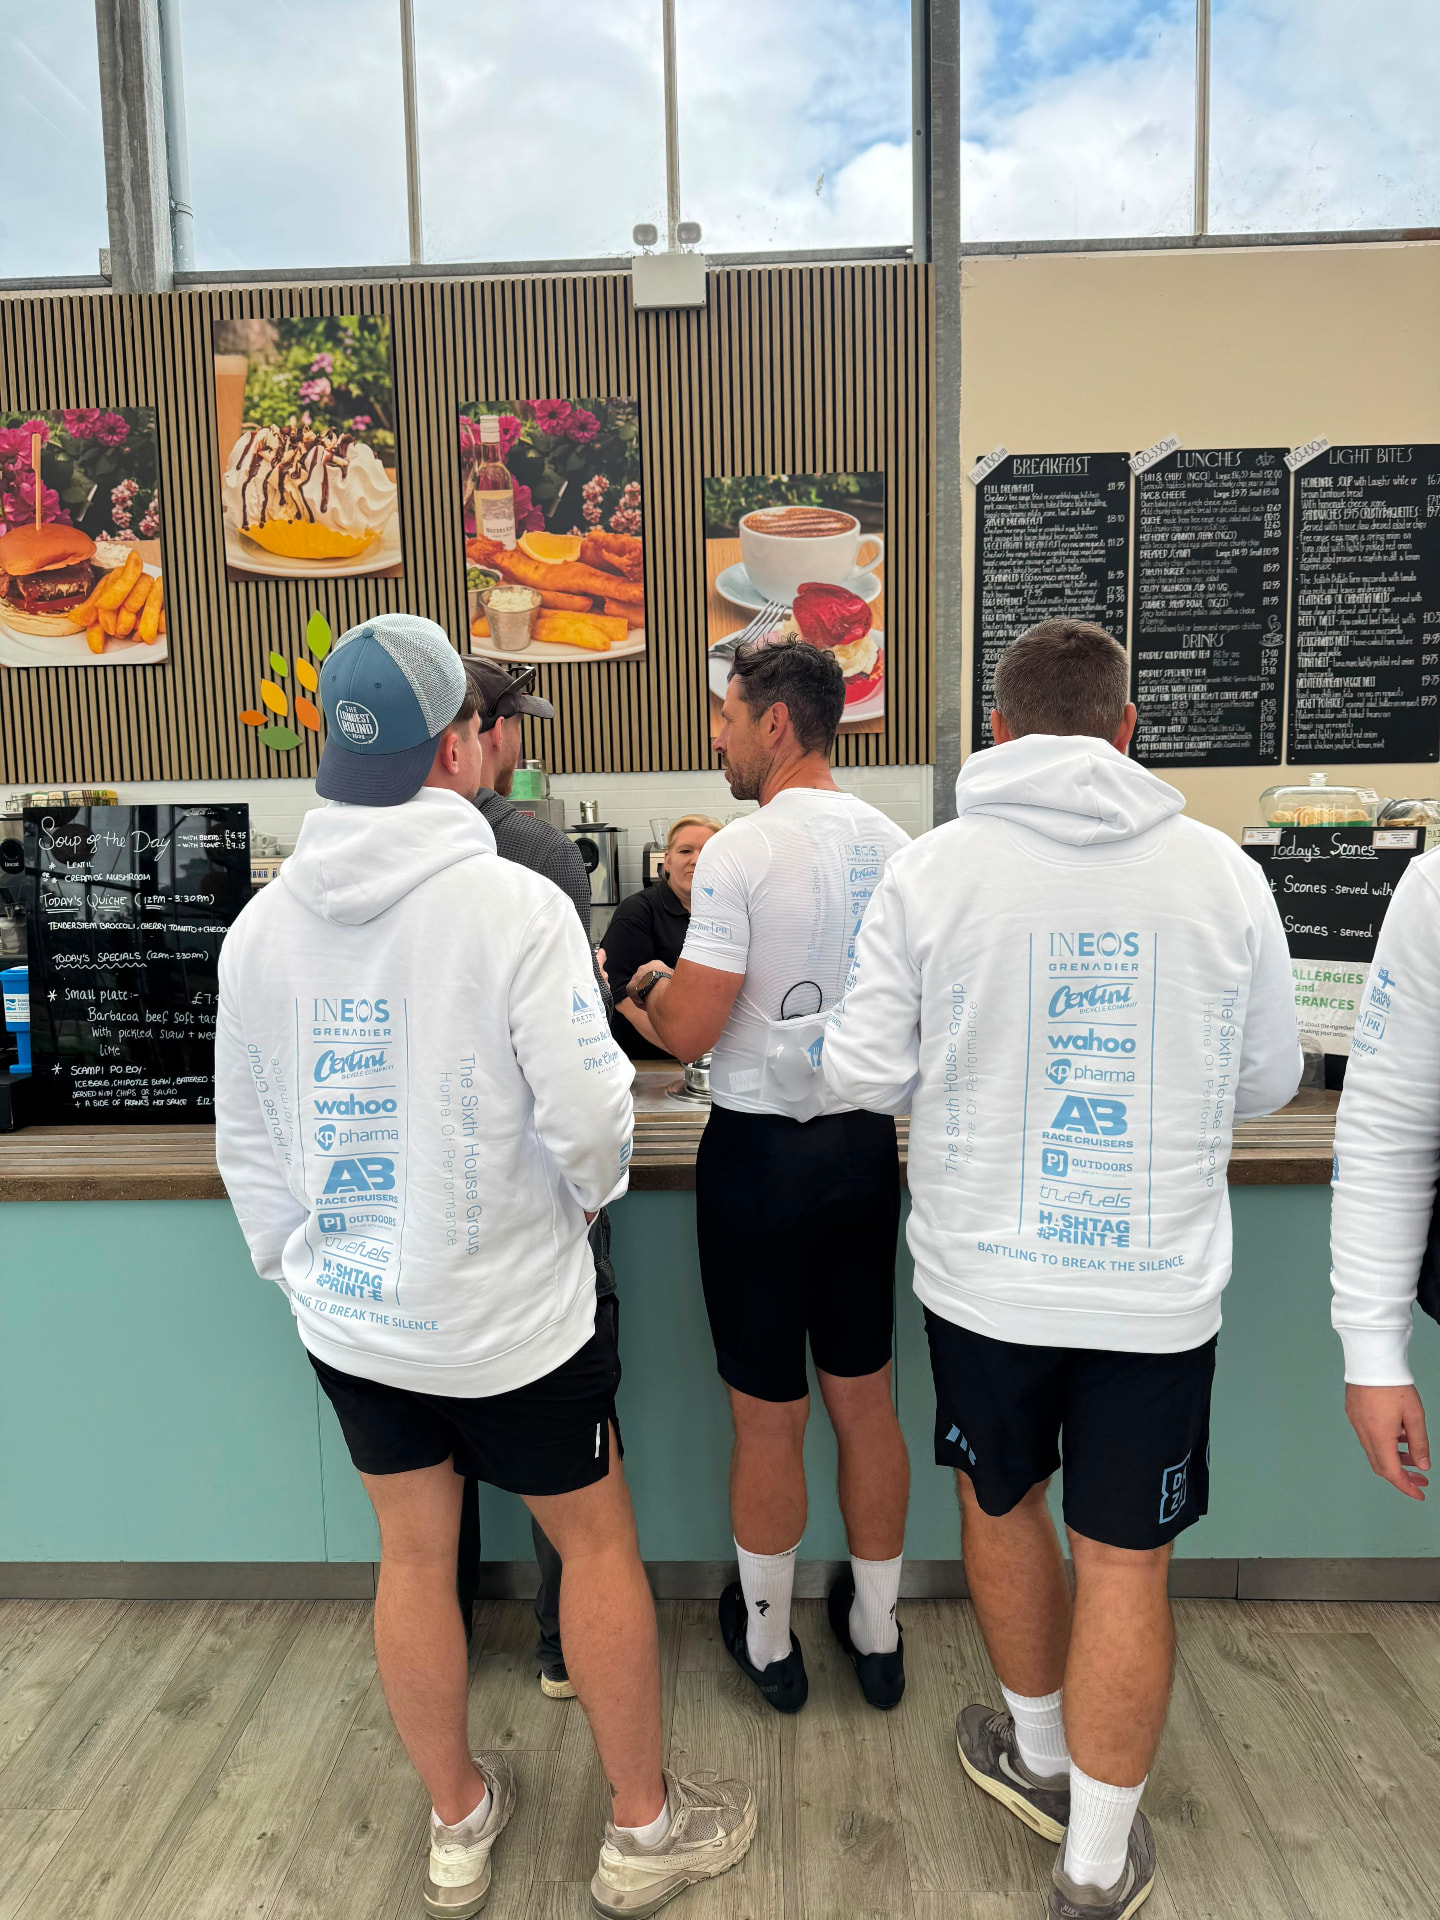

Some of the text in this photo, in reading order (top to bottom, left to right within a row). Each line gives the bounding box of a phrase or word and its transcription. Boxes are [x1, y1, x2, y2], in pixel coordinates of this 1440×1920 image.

[1177, 451, 1242, 468] LUNCHES
[1329, 448, 1372, 465] LIGHT
[1377, 447, 1413, 464] BITES
[1014, 456, 1091, 475] BREAKFAST
[1183, 632, 1226, 649] DRINKS
[340, 710, 370, 723] LONGEST
[345, 705, 358, 713] THE
[342, 720, 373, 734] ROUND
[39, 816, 172, 861] Soup of the Day
[1330, 832, 1376, 856] Scones
[845, 844, 877, 856] INEOS
[66, 860, 94, 870] LENTIL
[65, 874, 92, 883] CREAM
[93, 874, 103, 882] OF
[1283, 874, 1327, 894] Scones
[86, 893, 128, 911] QUICHE
[48, 922, 97, 931] TENDERSTEM
[141, 922, 166, 932] CHERRY
[168, 924, 196, 932] TOMATO
[1284, 915, 1373, 938] Scones served
[1049, 932, 1139, 957] INEOS
[52, 952, 141, 964] TODAY'S SPECIALS
[1049, 963, 1138, 971] GRENADIER
[1292, 968, 1364, 985] ALLERGIES
[65, 988, 95, 1001] Small
[1295, 983, 1314, 992] and
[1373, 986, 1390, 1001] ROYAL
[1079, 1001, 1138, 1014] BICYCLE COMPANY
[1295, 995, 1355, 1011] ERANCES
[1371, 993, 1390, 1008] NAVY
[87, 1007, 195, 1024] Barbacoa beef soft
[313, 998, 390, 1023] INEOS
[313, 1028, 391, 1037] GRENADIER
[1203, 1002, 1214, 1047] Home
[1366, 1018, 1380, 1031] PR
[92, 1027, 184, 1042] With pickled slaw
[1047, 1028, 1136, 1053] wahoo
[965, 1001, 978, 1092] Performance
[1353, 1037, 1377, 1055] quers
[70, 1065, 104, 1076] SCAMPI
[247, 1044, 269, 1093] Group
[342, 1064, 394, 1080] BICYCLE COMPANY
[583, 1057, 603, 1071] The
[113, 1079, 149, 1087] CHIPOTLE
[176, 1075, 208, 1084] BATTERED
[943, 983, 967, 1172] The Sixth House Group
[1074, 1064, 1135, 1082] pharma
[72, 1090, 96, 1099] SERVED
[116, 1089, 136, 1097] CHIPS
[440, 1072, 452, 1117] Home
[1206, 985, 1239, 1191] The Sixth House Group
[314, 1093, 397, 1116] wahoo
[264, 1099, 289, 1147] House
[1050, 1095, 1128, 1136] AB
[1196, 1079, 1214, 1176] Performance
[340, 1129, 399, 1146] pharma
[963, 1122, 976, 1164] Home
[1042, 1132, 1133, 1148] RACE CRUISERS
[460, 1053, 482, 1256] The Sixth House Group
[1046, 1152, 1133, 1172] PJ OUTDOORS
[322, 1157, 395, 1194] AB
[316, 1194, 398, 1206] RACE CRUISERS
[442, 1149, 457, 1246] Performance
[324, 1217, 340, 1230] PJ
[349, 1214, 396, 1227] OUTDOORS
[978, 1241, 1185, 1272] BATTLING TO BREAK THE SILENCE
[315, 1299, 439, 1331] TO BREAK THE SILENCE
